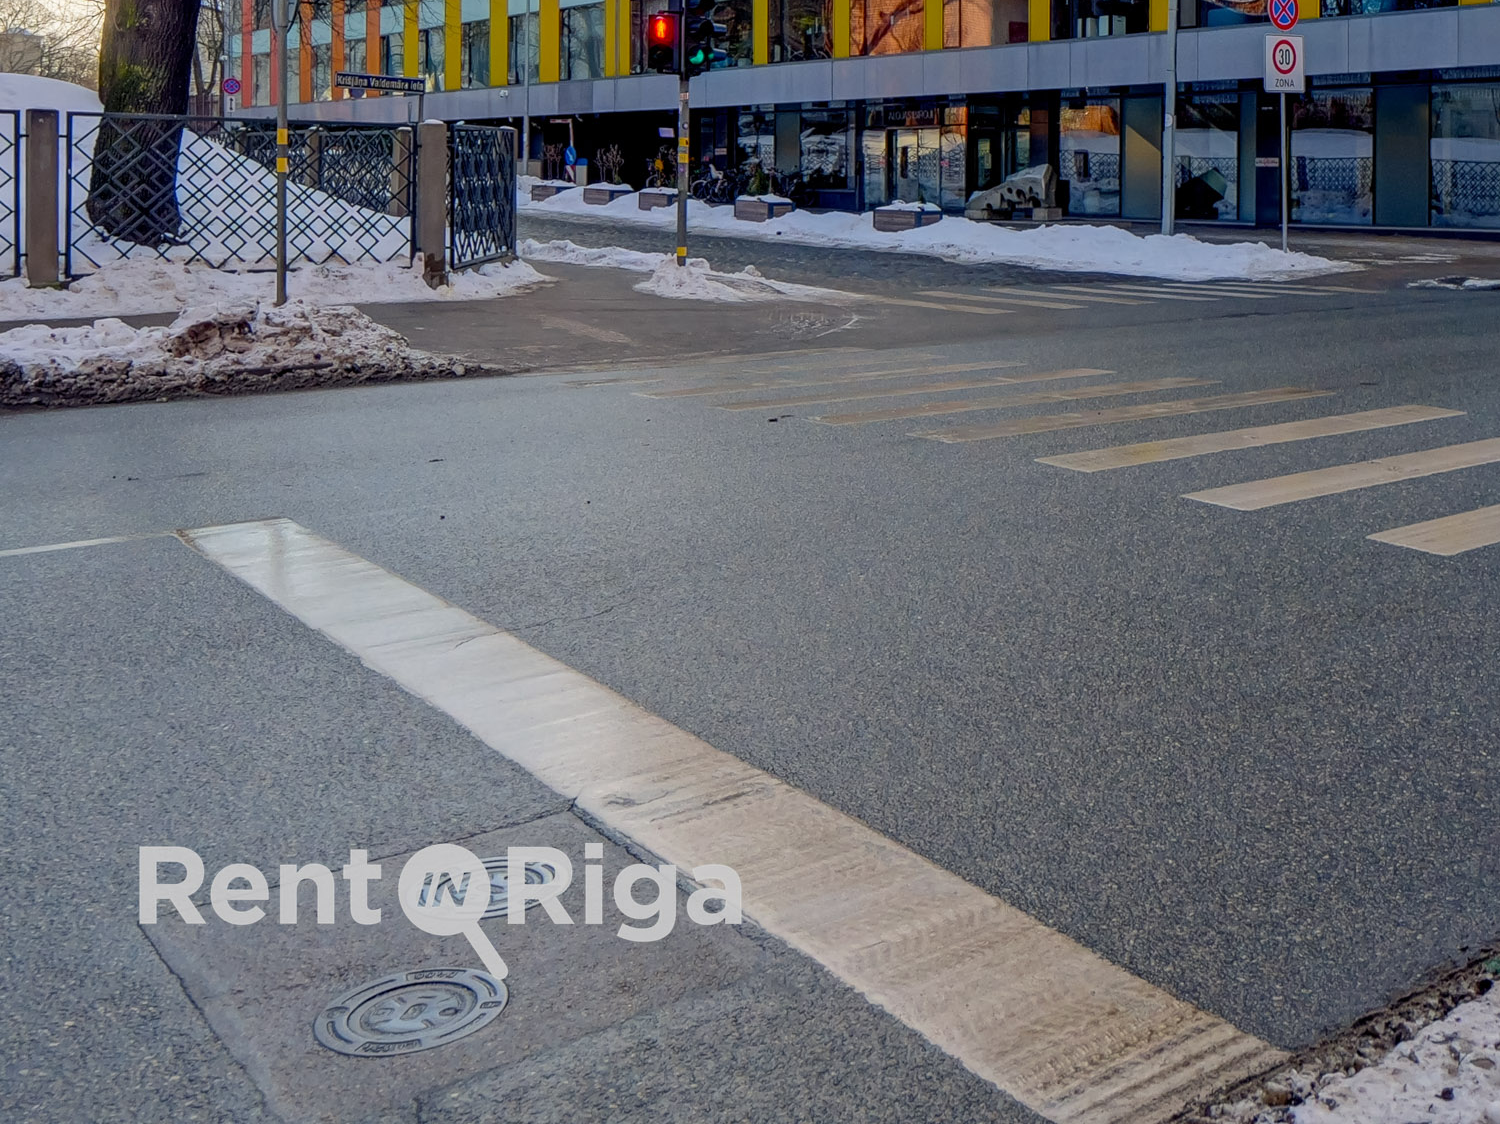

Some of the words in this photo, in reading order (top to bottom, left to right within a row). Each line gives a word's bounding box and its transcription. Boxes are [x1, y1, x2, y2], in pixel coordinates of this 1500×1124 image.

[1278, 48, 1291, 65] 30
[370, 77, 409, 90] Valdemāra
[1275, 78, 1295, 87] ZONA
